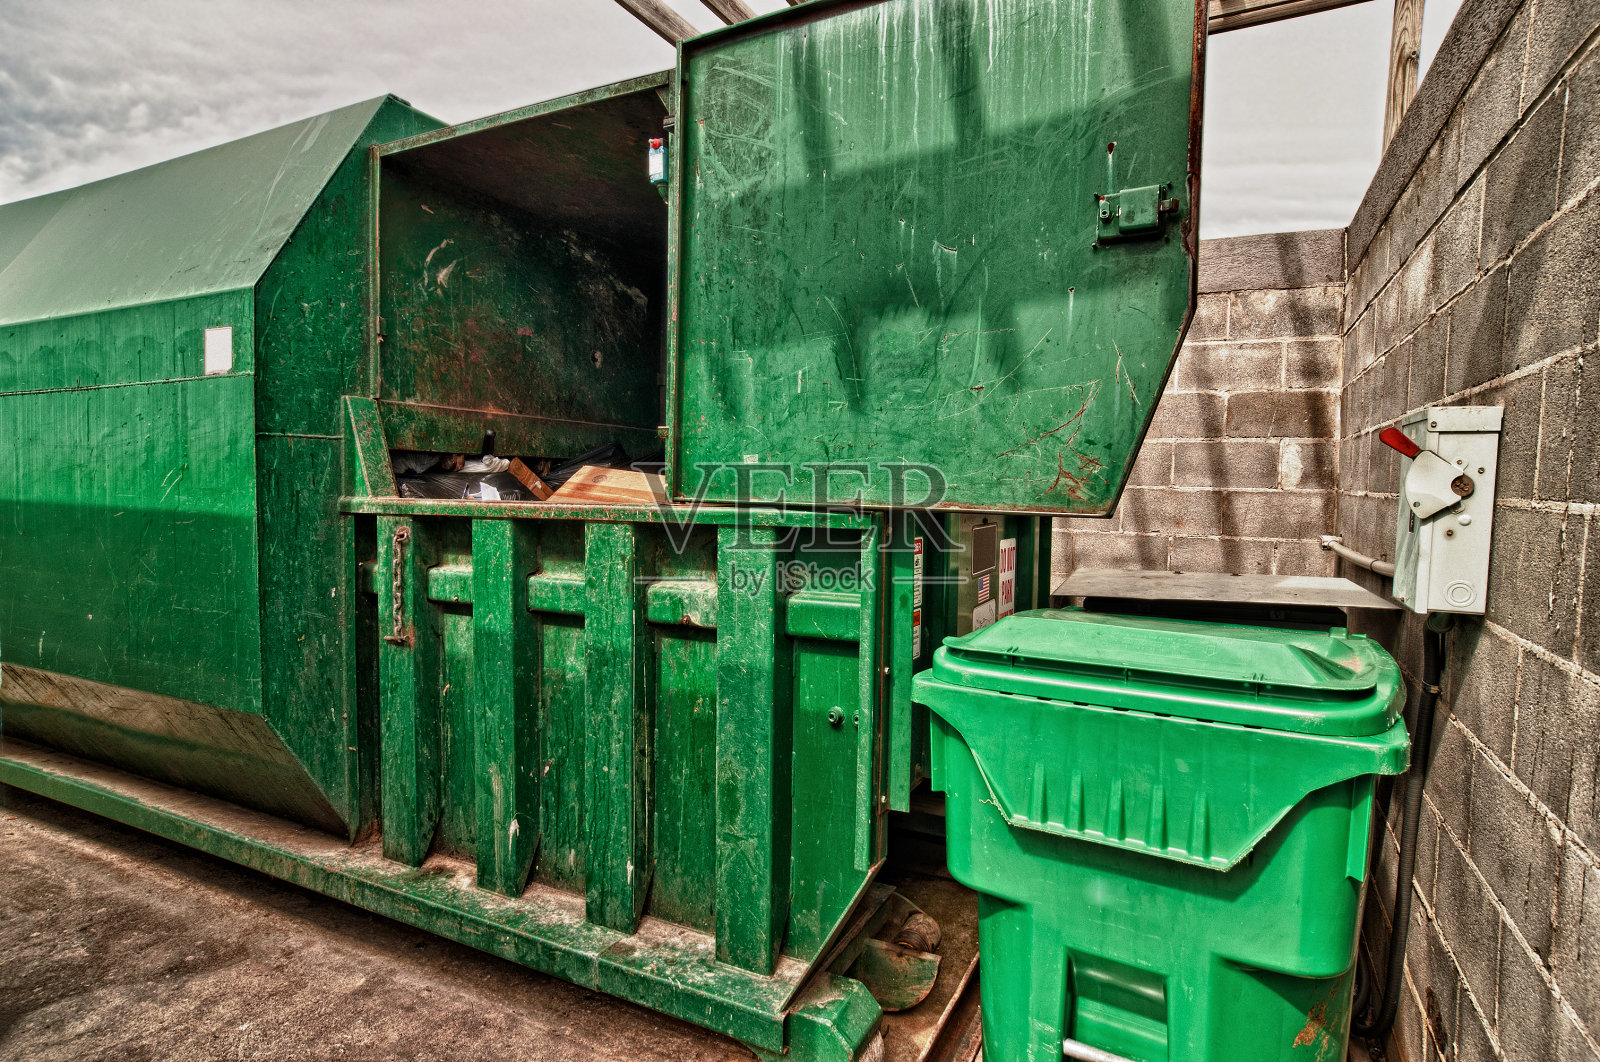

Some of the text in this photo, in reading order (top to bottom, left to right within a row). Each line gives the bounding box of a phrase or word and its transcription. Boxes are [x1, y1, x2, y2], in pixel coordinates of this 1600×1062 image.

[1000, 546, 1016, 574] DO NOT
[1001, 578, 1013, 606] PARK
